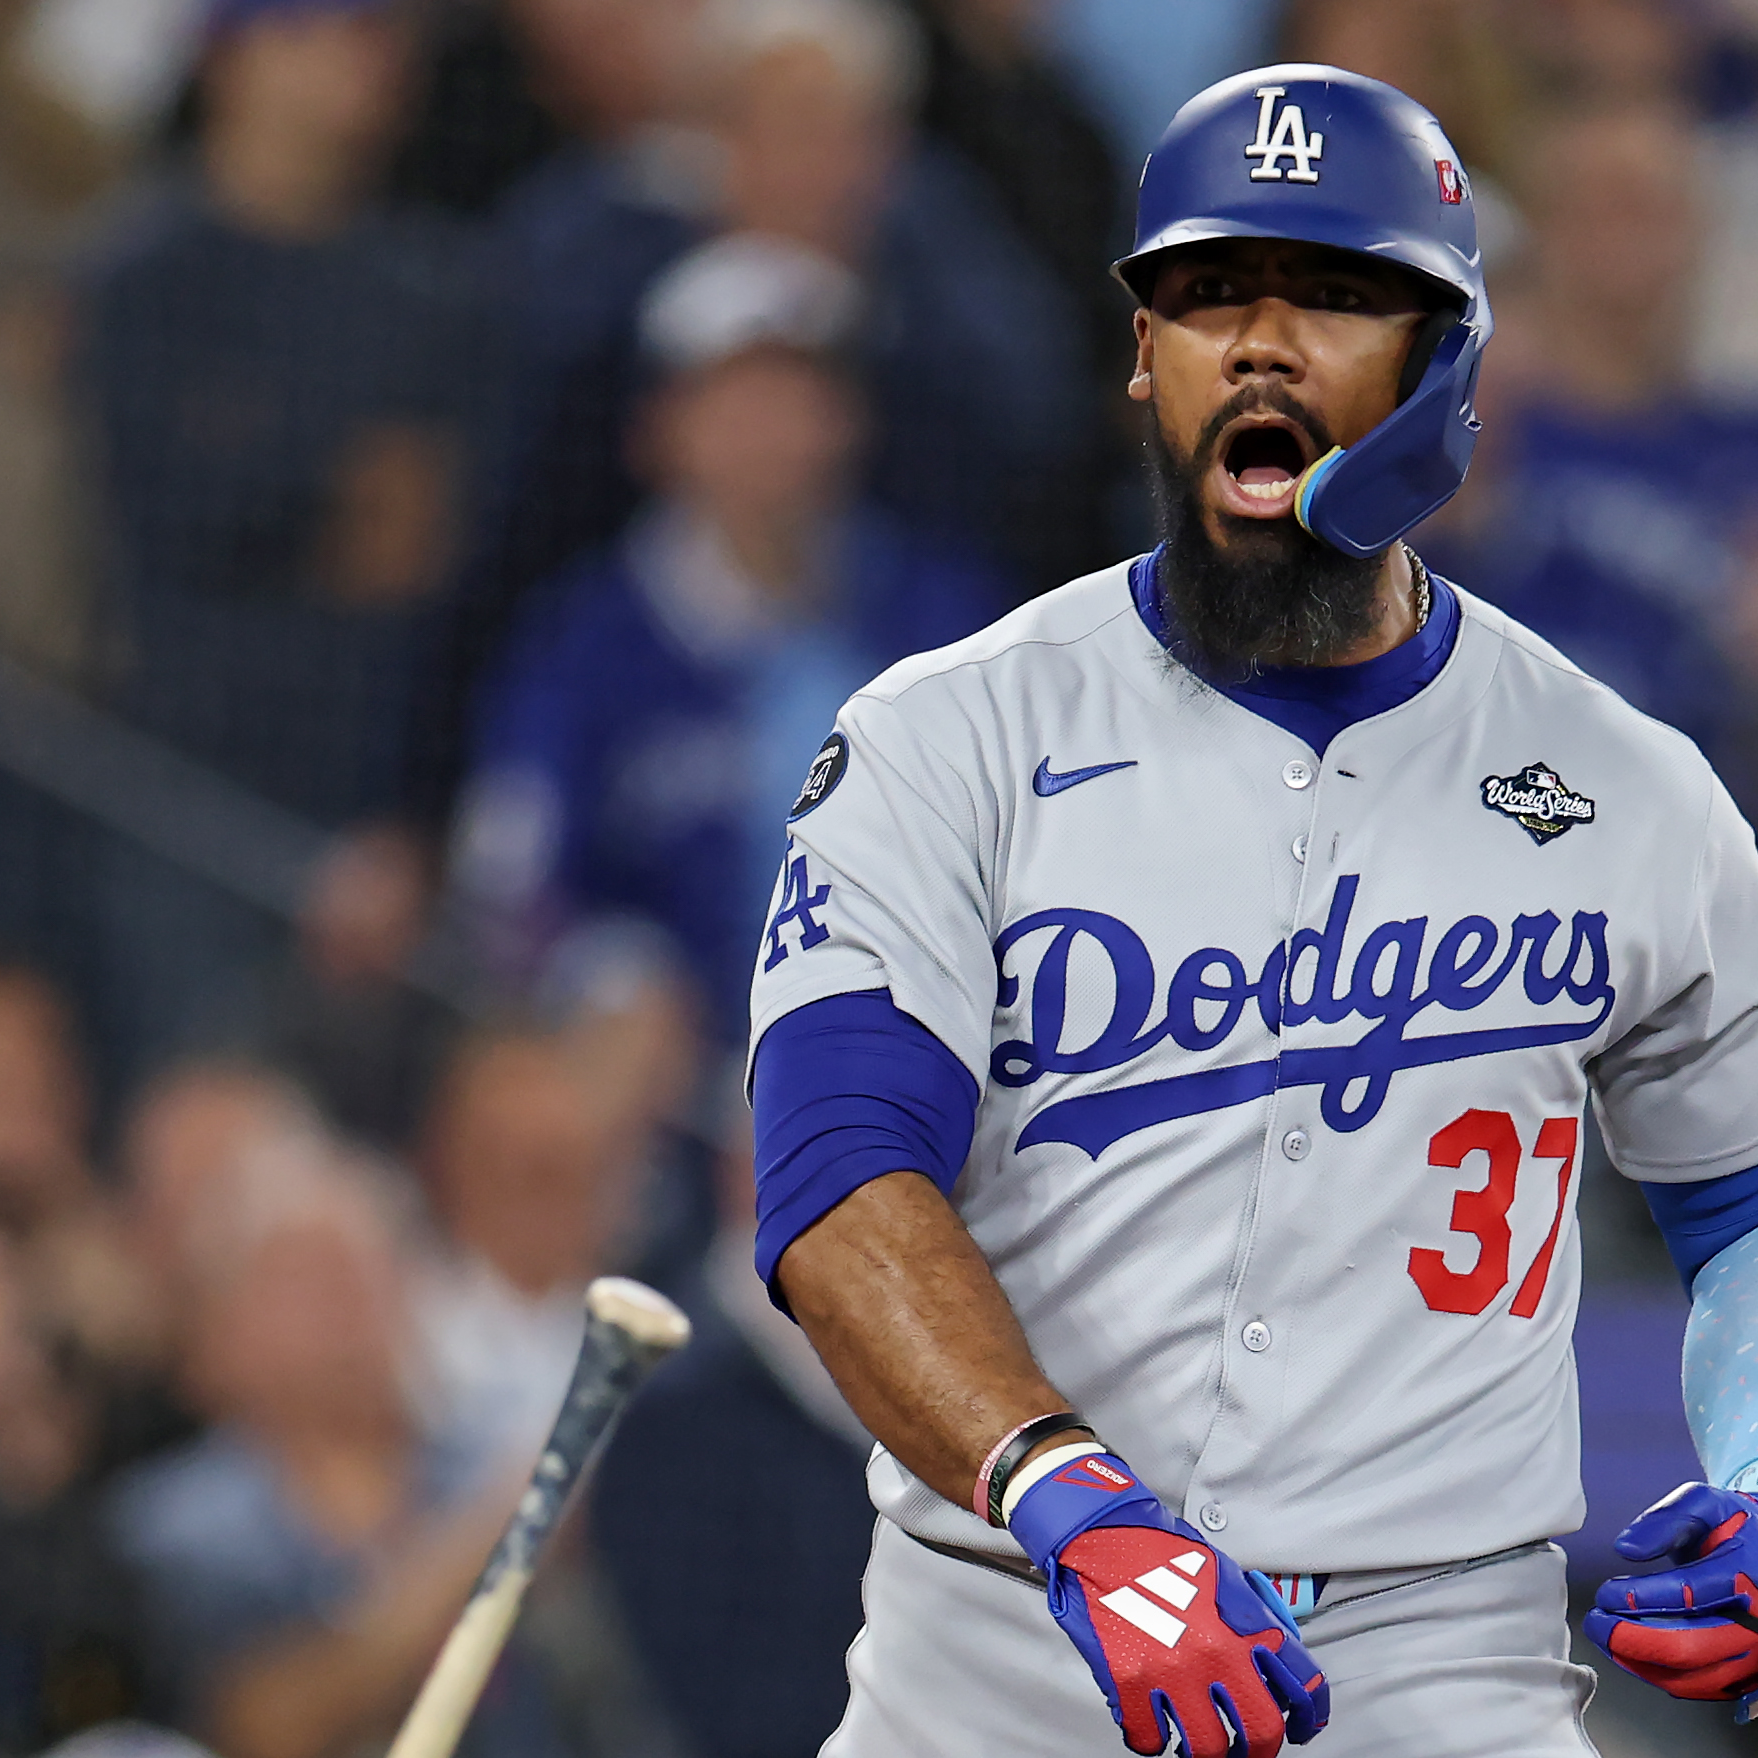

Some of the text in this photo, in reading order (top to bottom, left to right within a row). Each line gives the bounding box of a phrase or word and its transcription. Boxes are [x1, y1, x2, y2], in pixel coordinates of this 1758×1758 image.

[1245, 86, 1324, 183] LA
[1486, 778, 1593, 820] World Series
[990, 874, 1615, 1133] Dodgers
[1407, 1108, 1578, 1319] 37
[1086, 1459, 1129, 1485] ADIZERO
